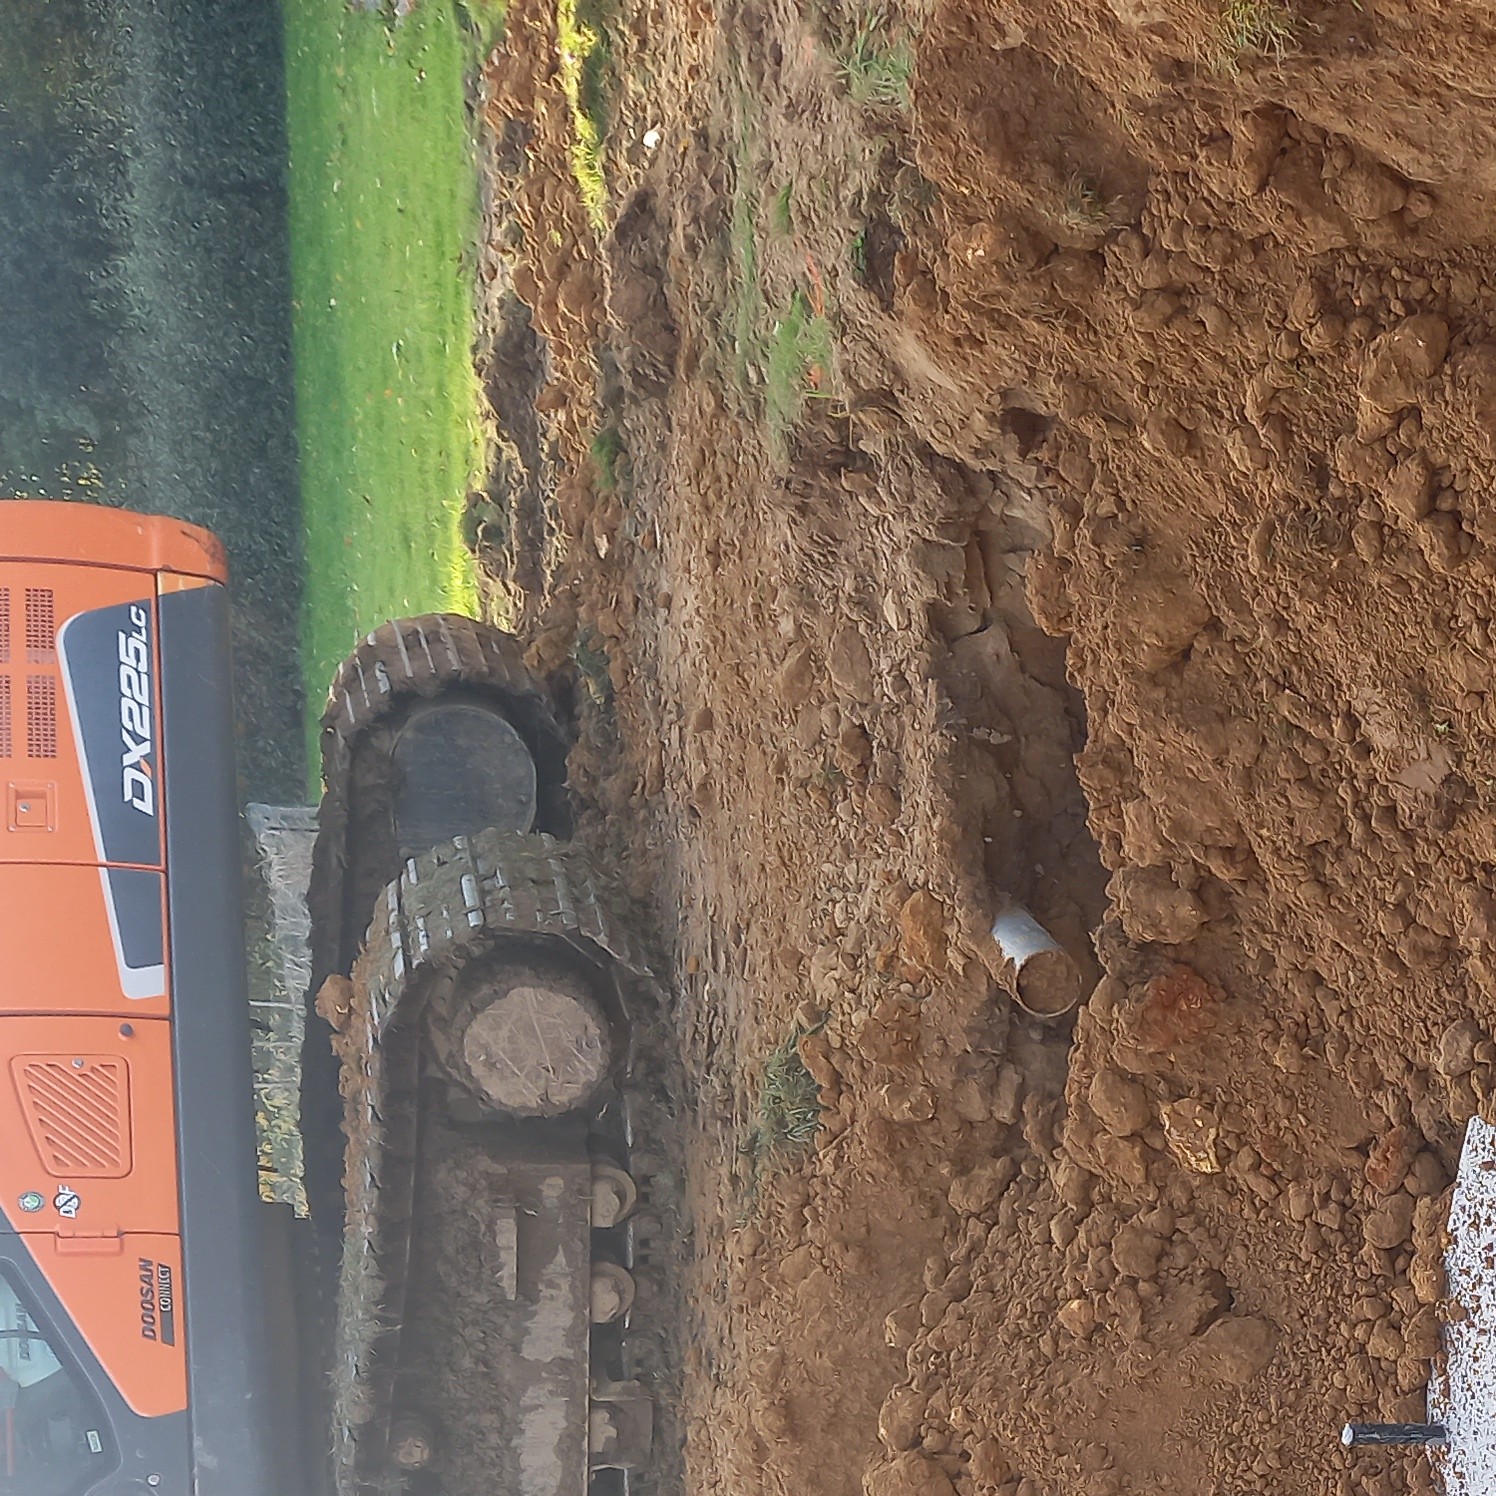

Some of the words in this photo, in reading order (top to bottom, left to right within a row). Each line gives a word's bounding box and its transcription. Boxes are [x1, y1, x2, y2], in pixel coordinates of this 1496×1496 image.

[118, 605, 154, 816] DX225LC
[139, 1257, 157, 1341] DOOSAN
[158, 1264, 171, 1311] CONNECT
